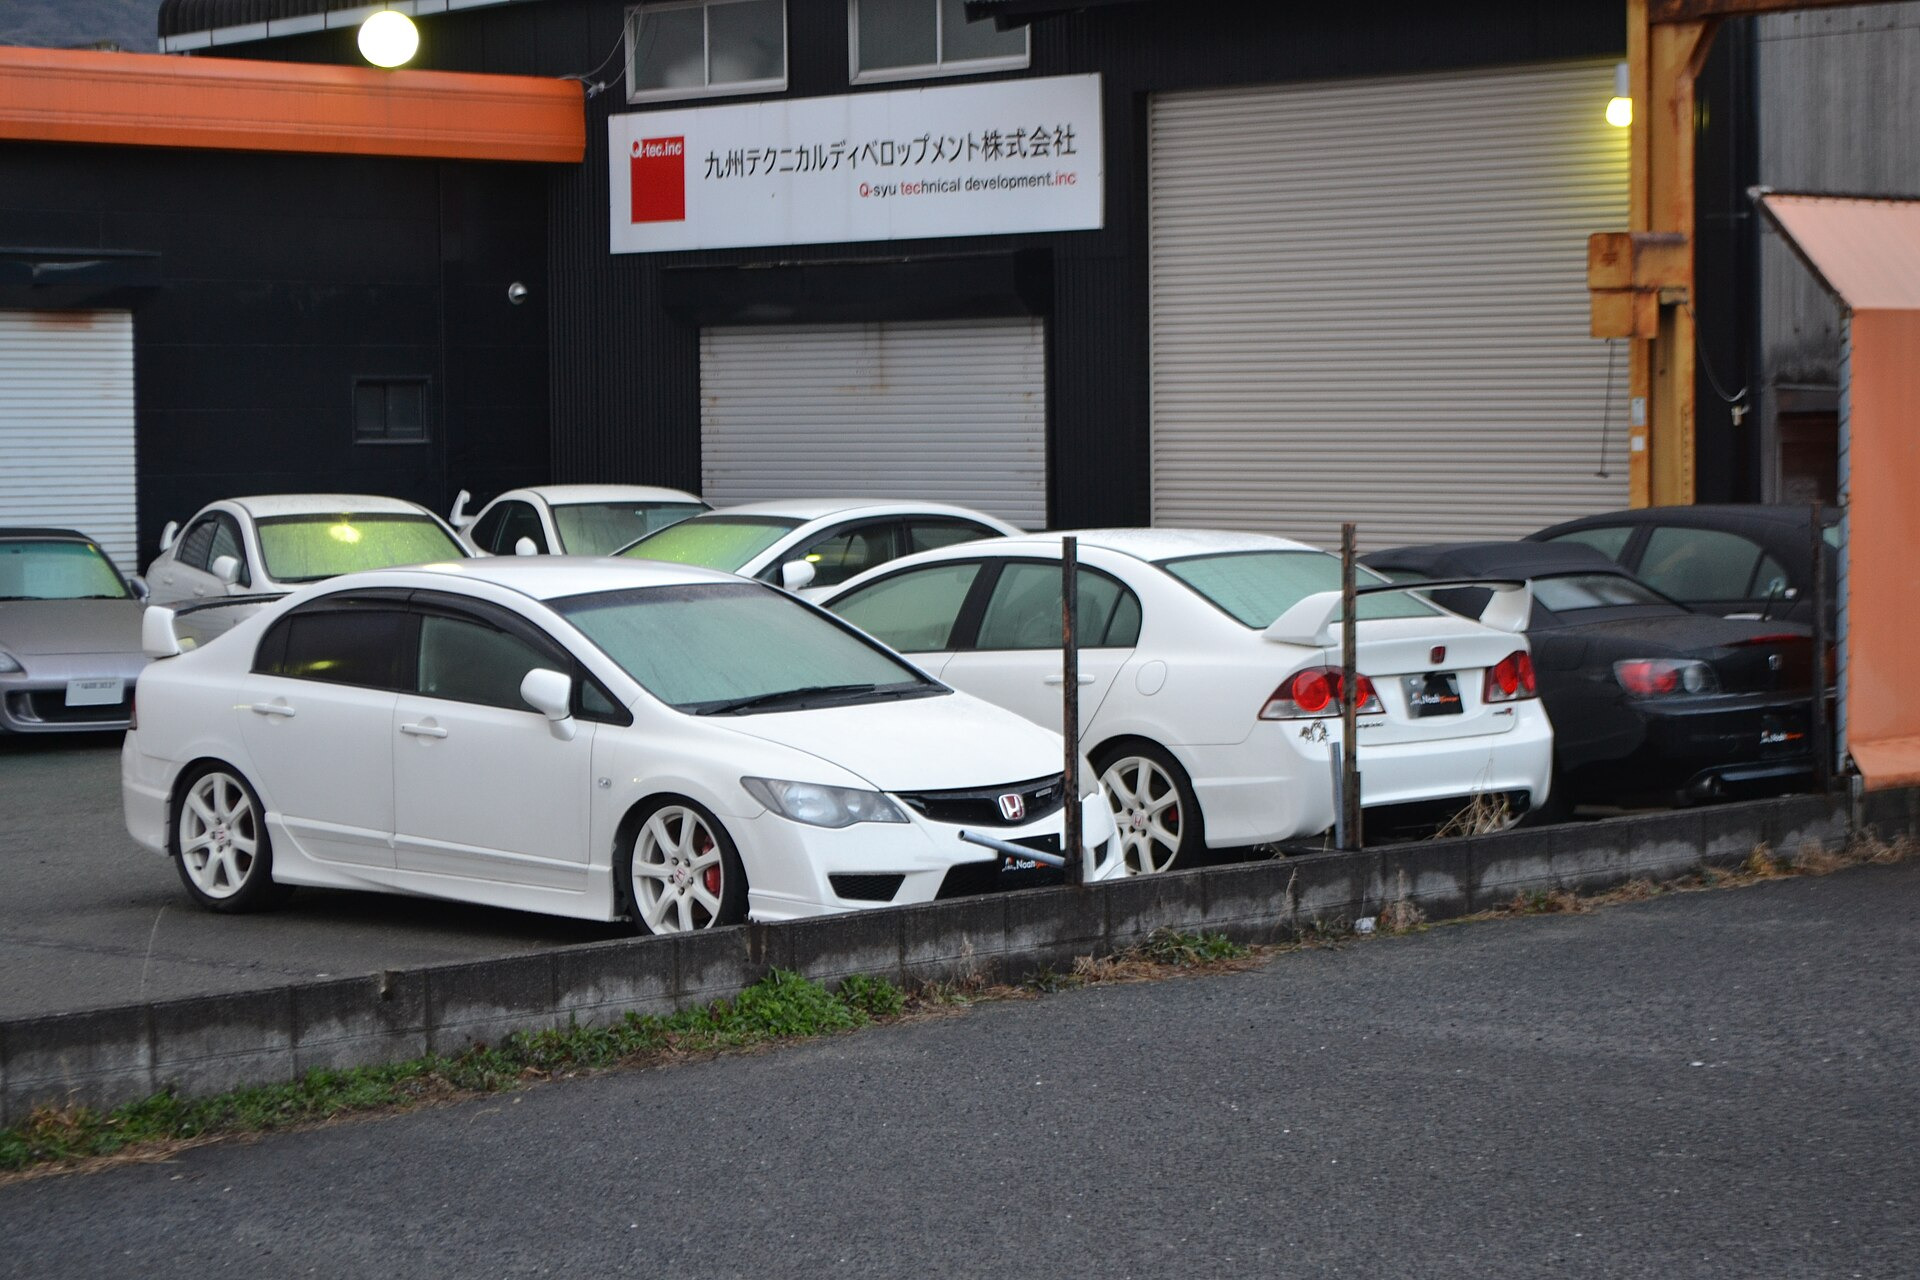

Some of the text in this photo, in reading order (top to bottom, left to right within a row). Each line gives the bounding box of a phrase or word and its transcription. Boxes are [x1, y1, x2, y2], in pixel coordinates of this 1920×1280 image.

[704, 123, 1077, 179] 九州テクニカルディベロップメント株式会社
[859, 172, 1077, 198] Q-syu technical development.inc
